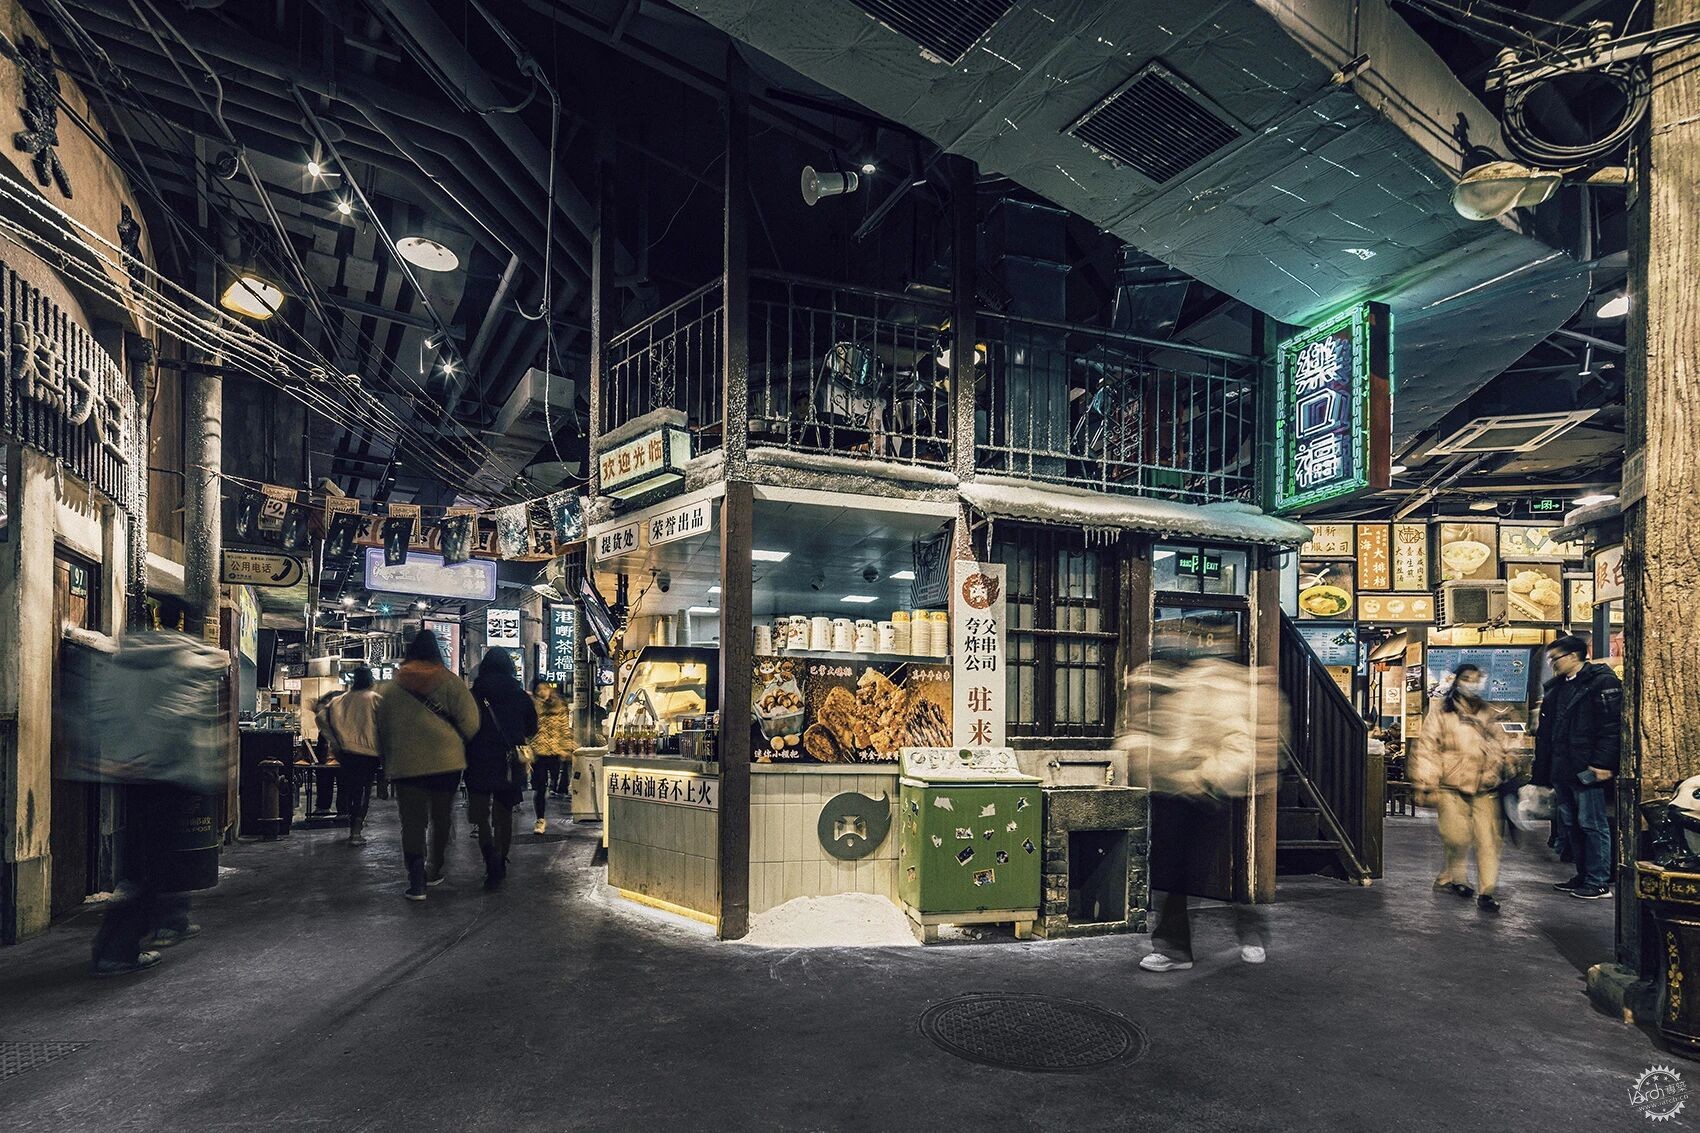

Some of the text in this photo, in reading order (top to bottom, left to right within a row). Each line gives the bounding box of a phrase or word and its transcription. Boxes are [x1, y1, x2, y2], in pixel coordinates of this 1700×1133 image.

[1295, 335, 1340, 488] 樂口福
[602, 439, 662, 481] 欢迎光临
[652, 507, 703, 540] 荣誉出品
[601, 528, 634, 555] 提货处
[1360, 527, 1373, 551] 上海
[230, 561, 272, 573] 公用电话
[1206, 562, 1219, 571] EXIT
[1373, 547, 1386, 587] 大排档
[965, 617, 997, 636] 夸父
[964, 635, 996, 654] 炸串
[965, 654, 997, 672] 公司
[546, 671, 567, 681] 月饼
[968, 686, 993, 746] 驻来
[609, 772, 712, 805] 草本卤油香不上火
